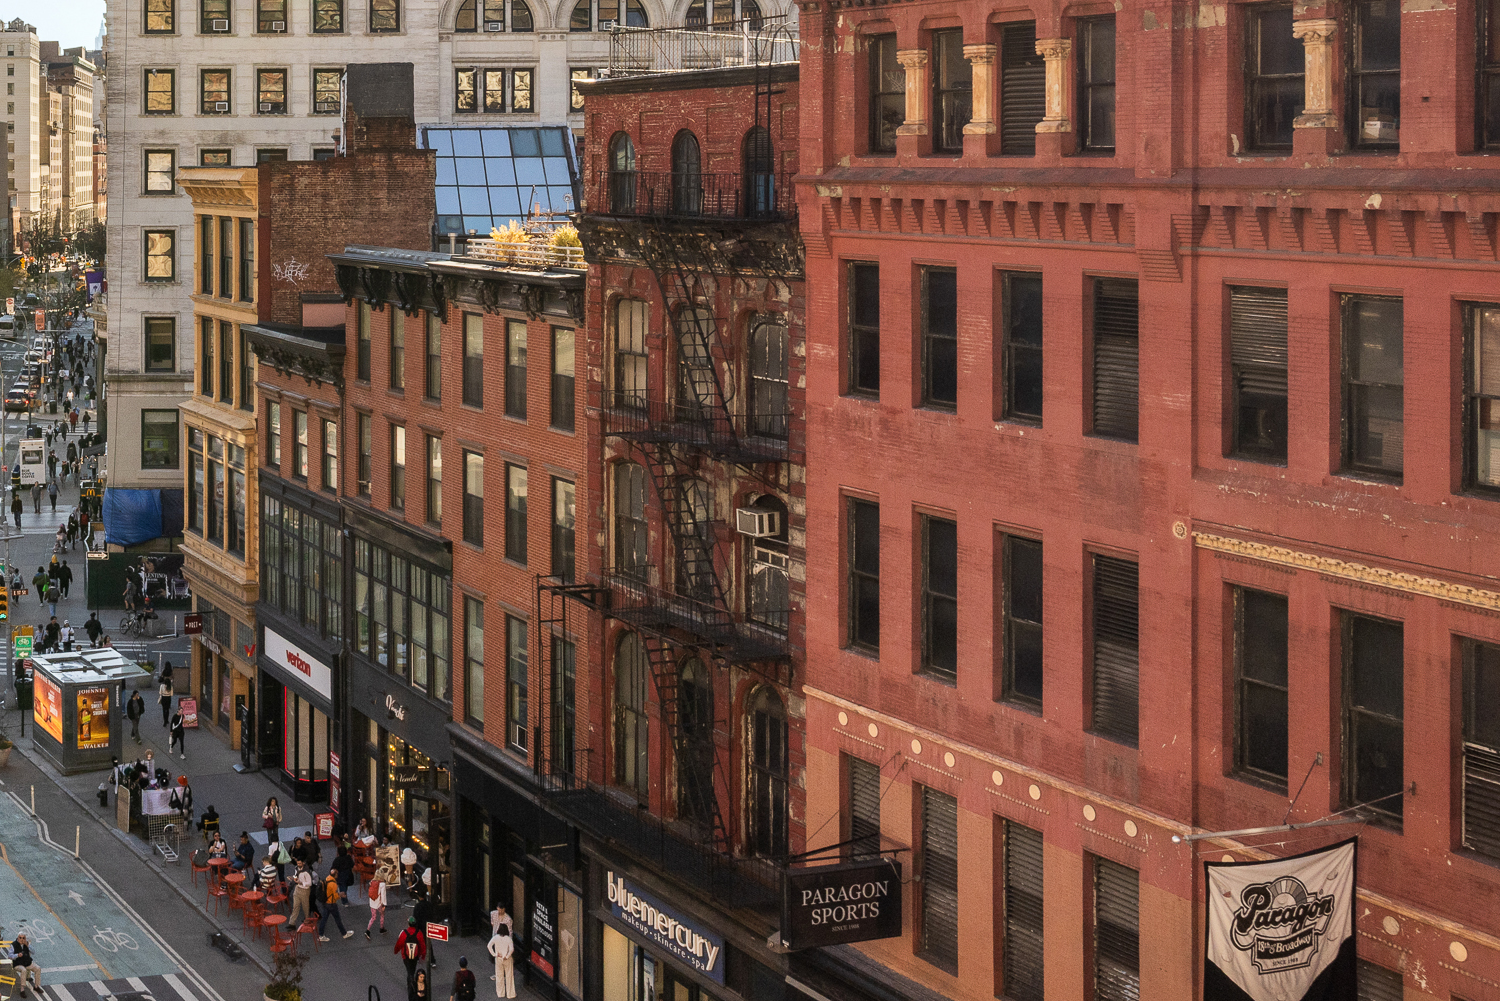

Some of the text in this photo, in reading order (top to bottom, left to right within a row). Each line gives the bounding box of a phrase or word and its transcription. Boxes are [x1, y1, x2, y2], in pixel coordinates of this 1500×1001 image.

[286, 650, 311, 677] verizon
[78, 688, 106, 696] JOHNNIE
[396, 773, 418, 782] Venchi
[802, 881, 889, 906] PARAGON
[536, 908, 549, 922] SPACE
[607, 871, 719, 971] bluemercury
[811, 902, 880, 925] SPORTS
[1235, 885, 1333, 935] Paragon
[533, 913, 553, 932] AVAILABLE
[622, 912, 705, 971] makeup skincare spa
[1276, 934, 1312, 953] Broadway
